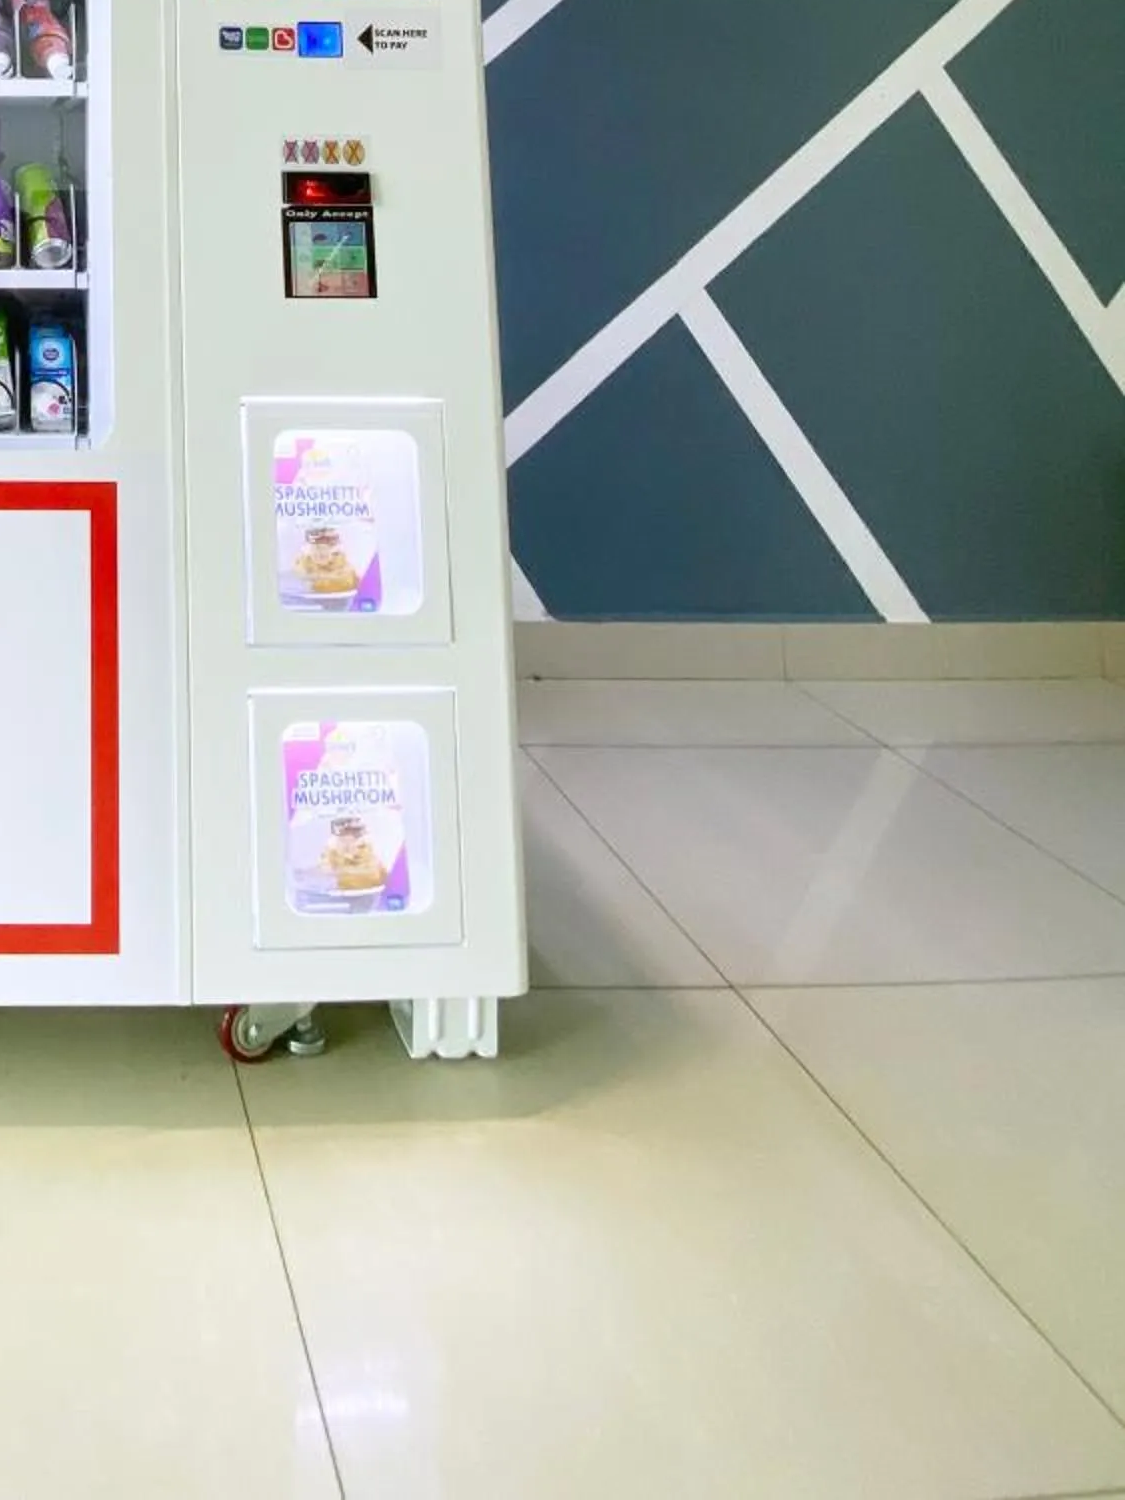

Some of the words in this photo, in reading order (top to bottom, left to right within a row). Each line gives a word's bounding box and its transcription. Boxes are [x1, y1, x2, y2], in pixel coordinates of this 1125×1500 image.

[375, 29, 400, 37] SCAN
[402, 29, 427, 38] HERE
[375, 41, 388, 49] TO
[390, 41, 408, 50] PAY
[286, 209, 317, 218] Only
[275, 486, 360, 501] SPAGHETTI
[299, 771, 386, 788] SPAGHETTI
[294, 787, 395, 805] MUSHROOM
